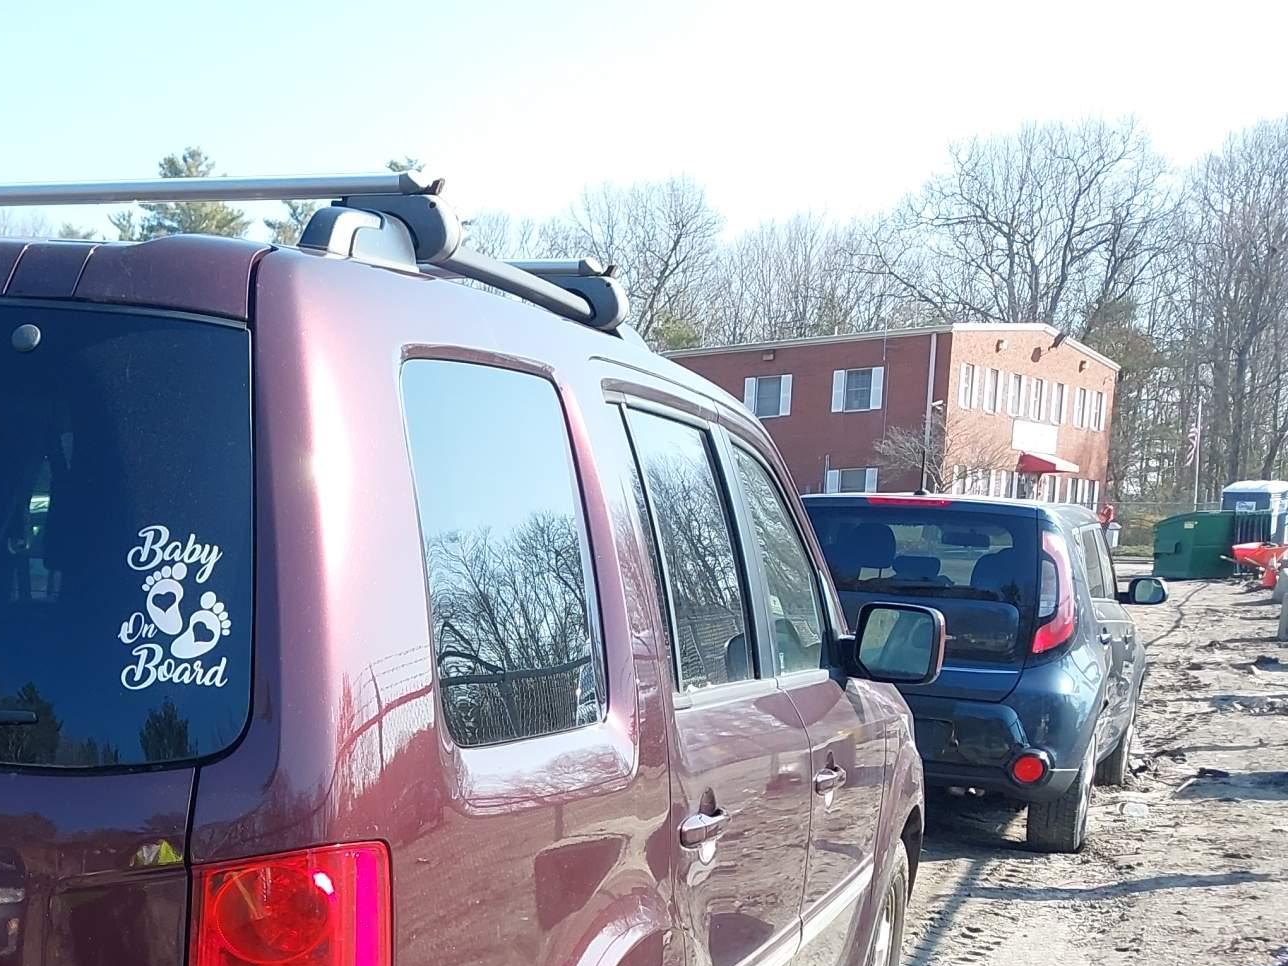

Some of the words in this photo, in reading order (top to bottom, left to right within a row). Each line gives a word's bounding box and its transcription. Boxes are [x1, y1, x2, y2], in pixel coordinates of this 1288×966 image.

[127, 525, 223, 583] Baby
[118, 612, 158, 643] On
[120, 643, 228, 690] Board
